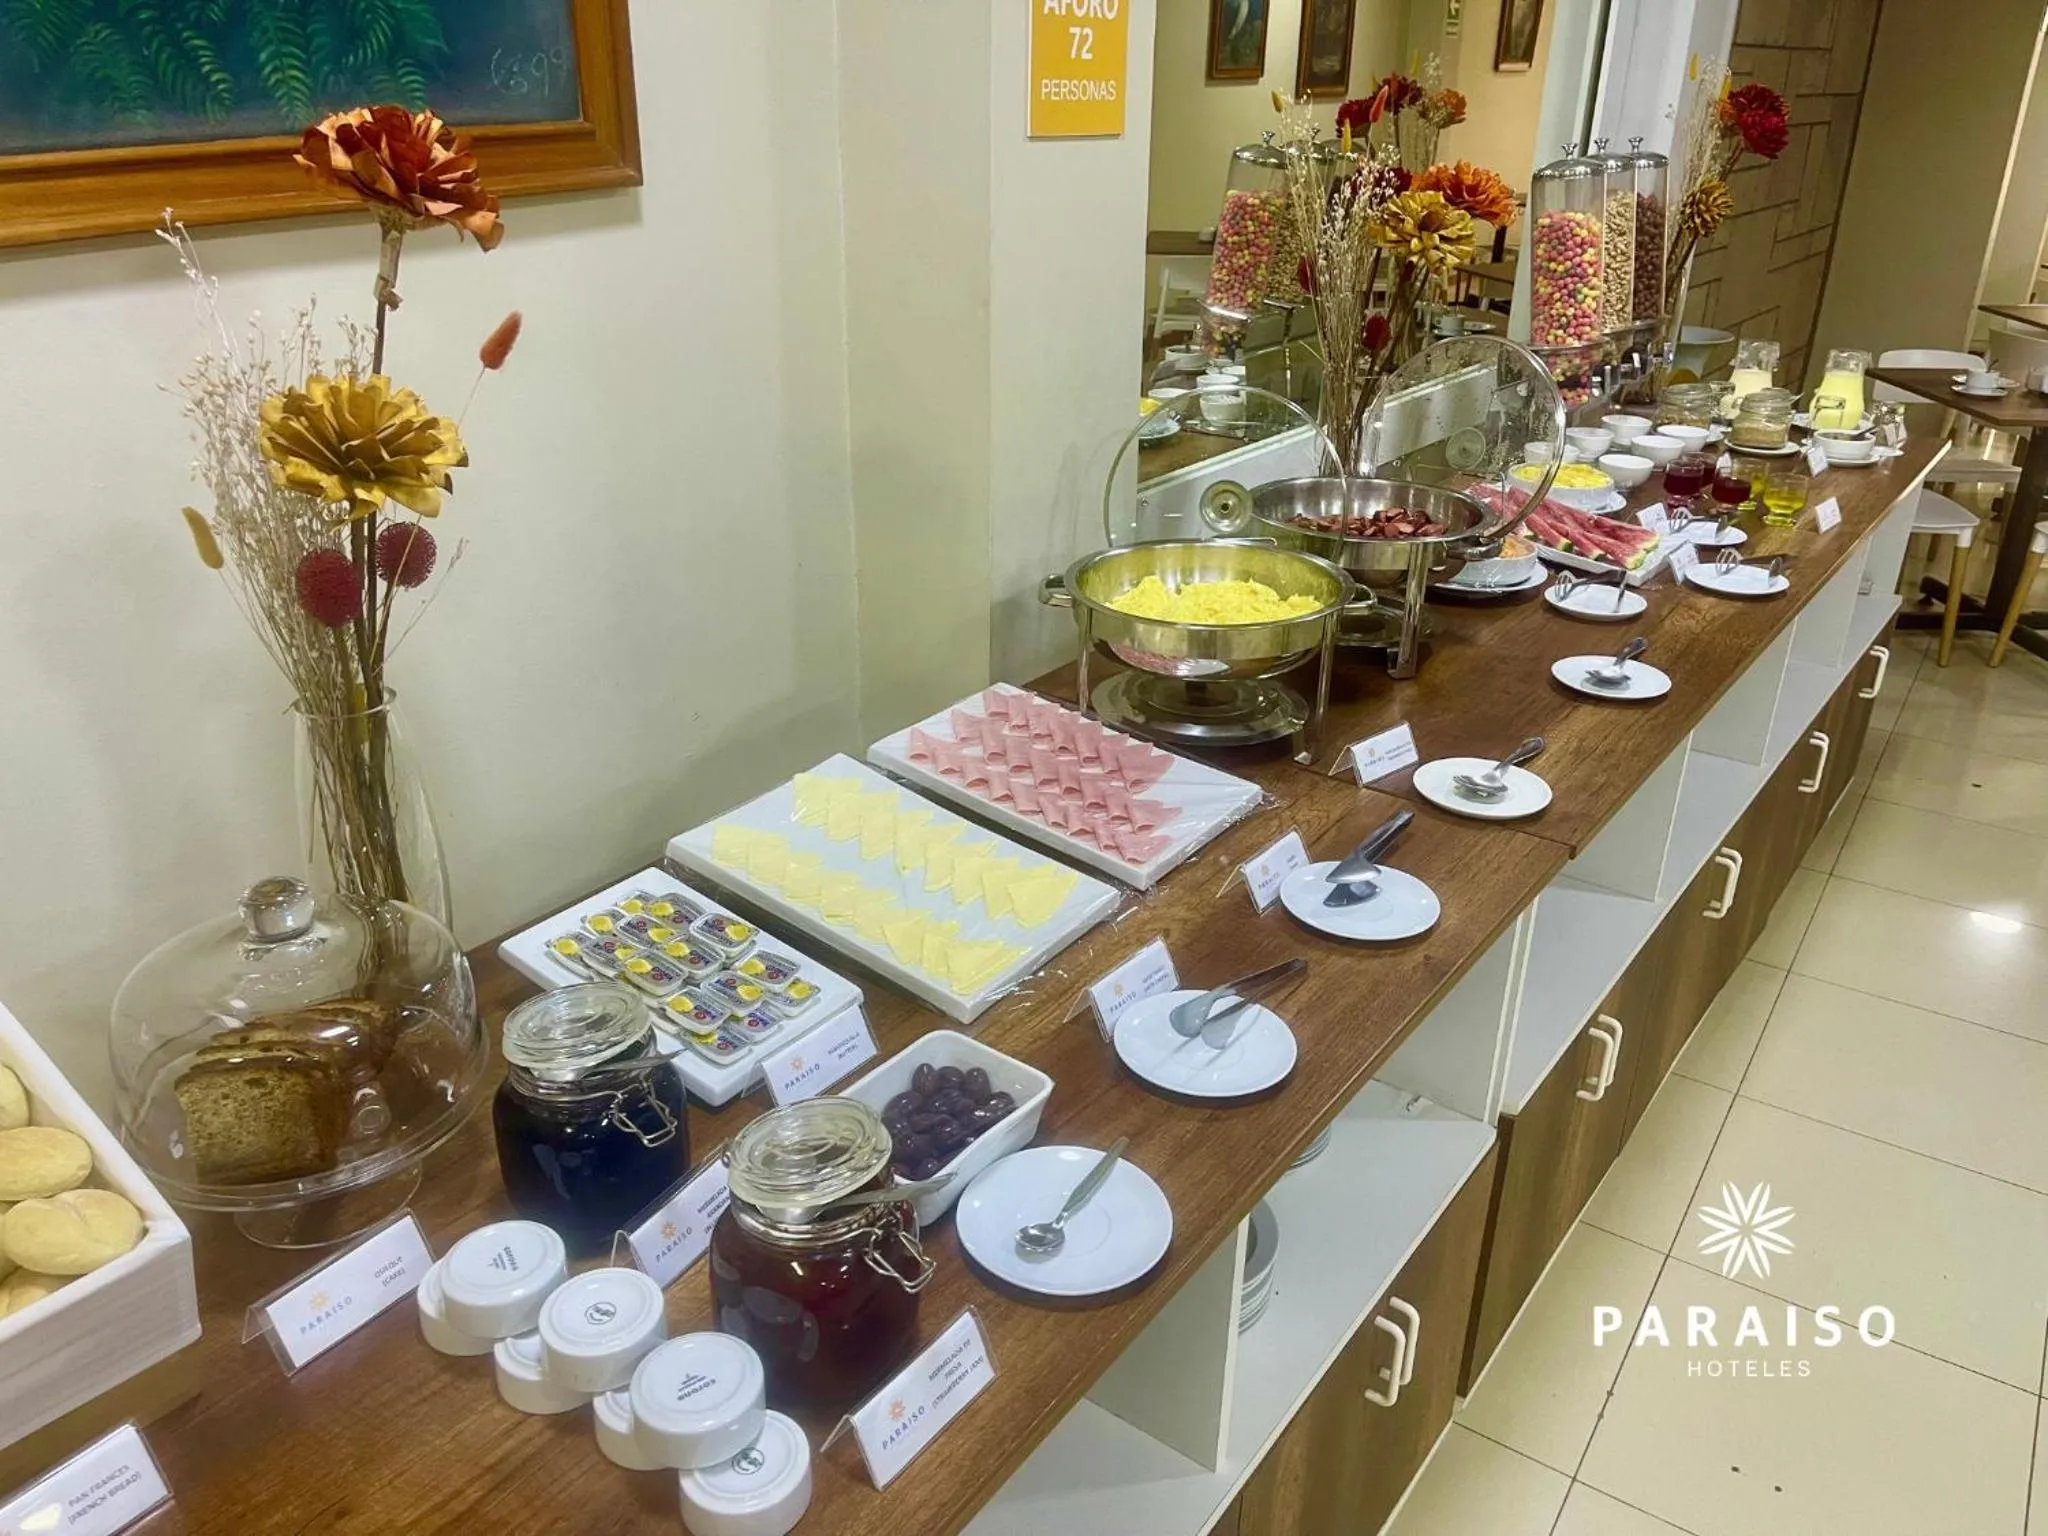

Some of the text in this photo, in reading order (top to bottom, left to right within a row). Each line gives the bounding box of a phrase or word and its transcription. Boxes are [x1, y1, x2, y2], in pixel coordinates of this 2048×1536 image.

[1069, 26, 1093, 60] 72
[1041, 79, 1117, 101] PERSONAS
[784, 1063, 820, 1091] PARAISO
[655, 1226, 693, 1263] PARAISO
[300, 1296, 353, 1335] PARAISO
[881, 1404, 926, 1451] PARAISO
